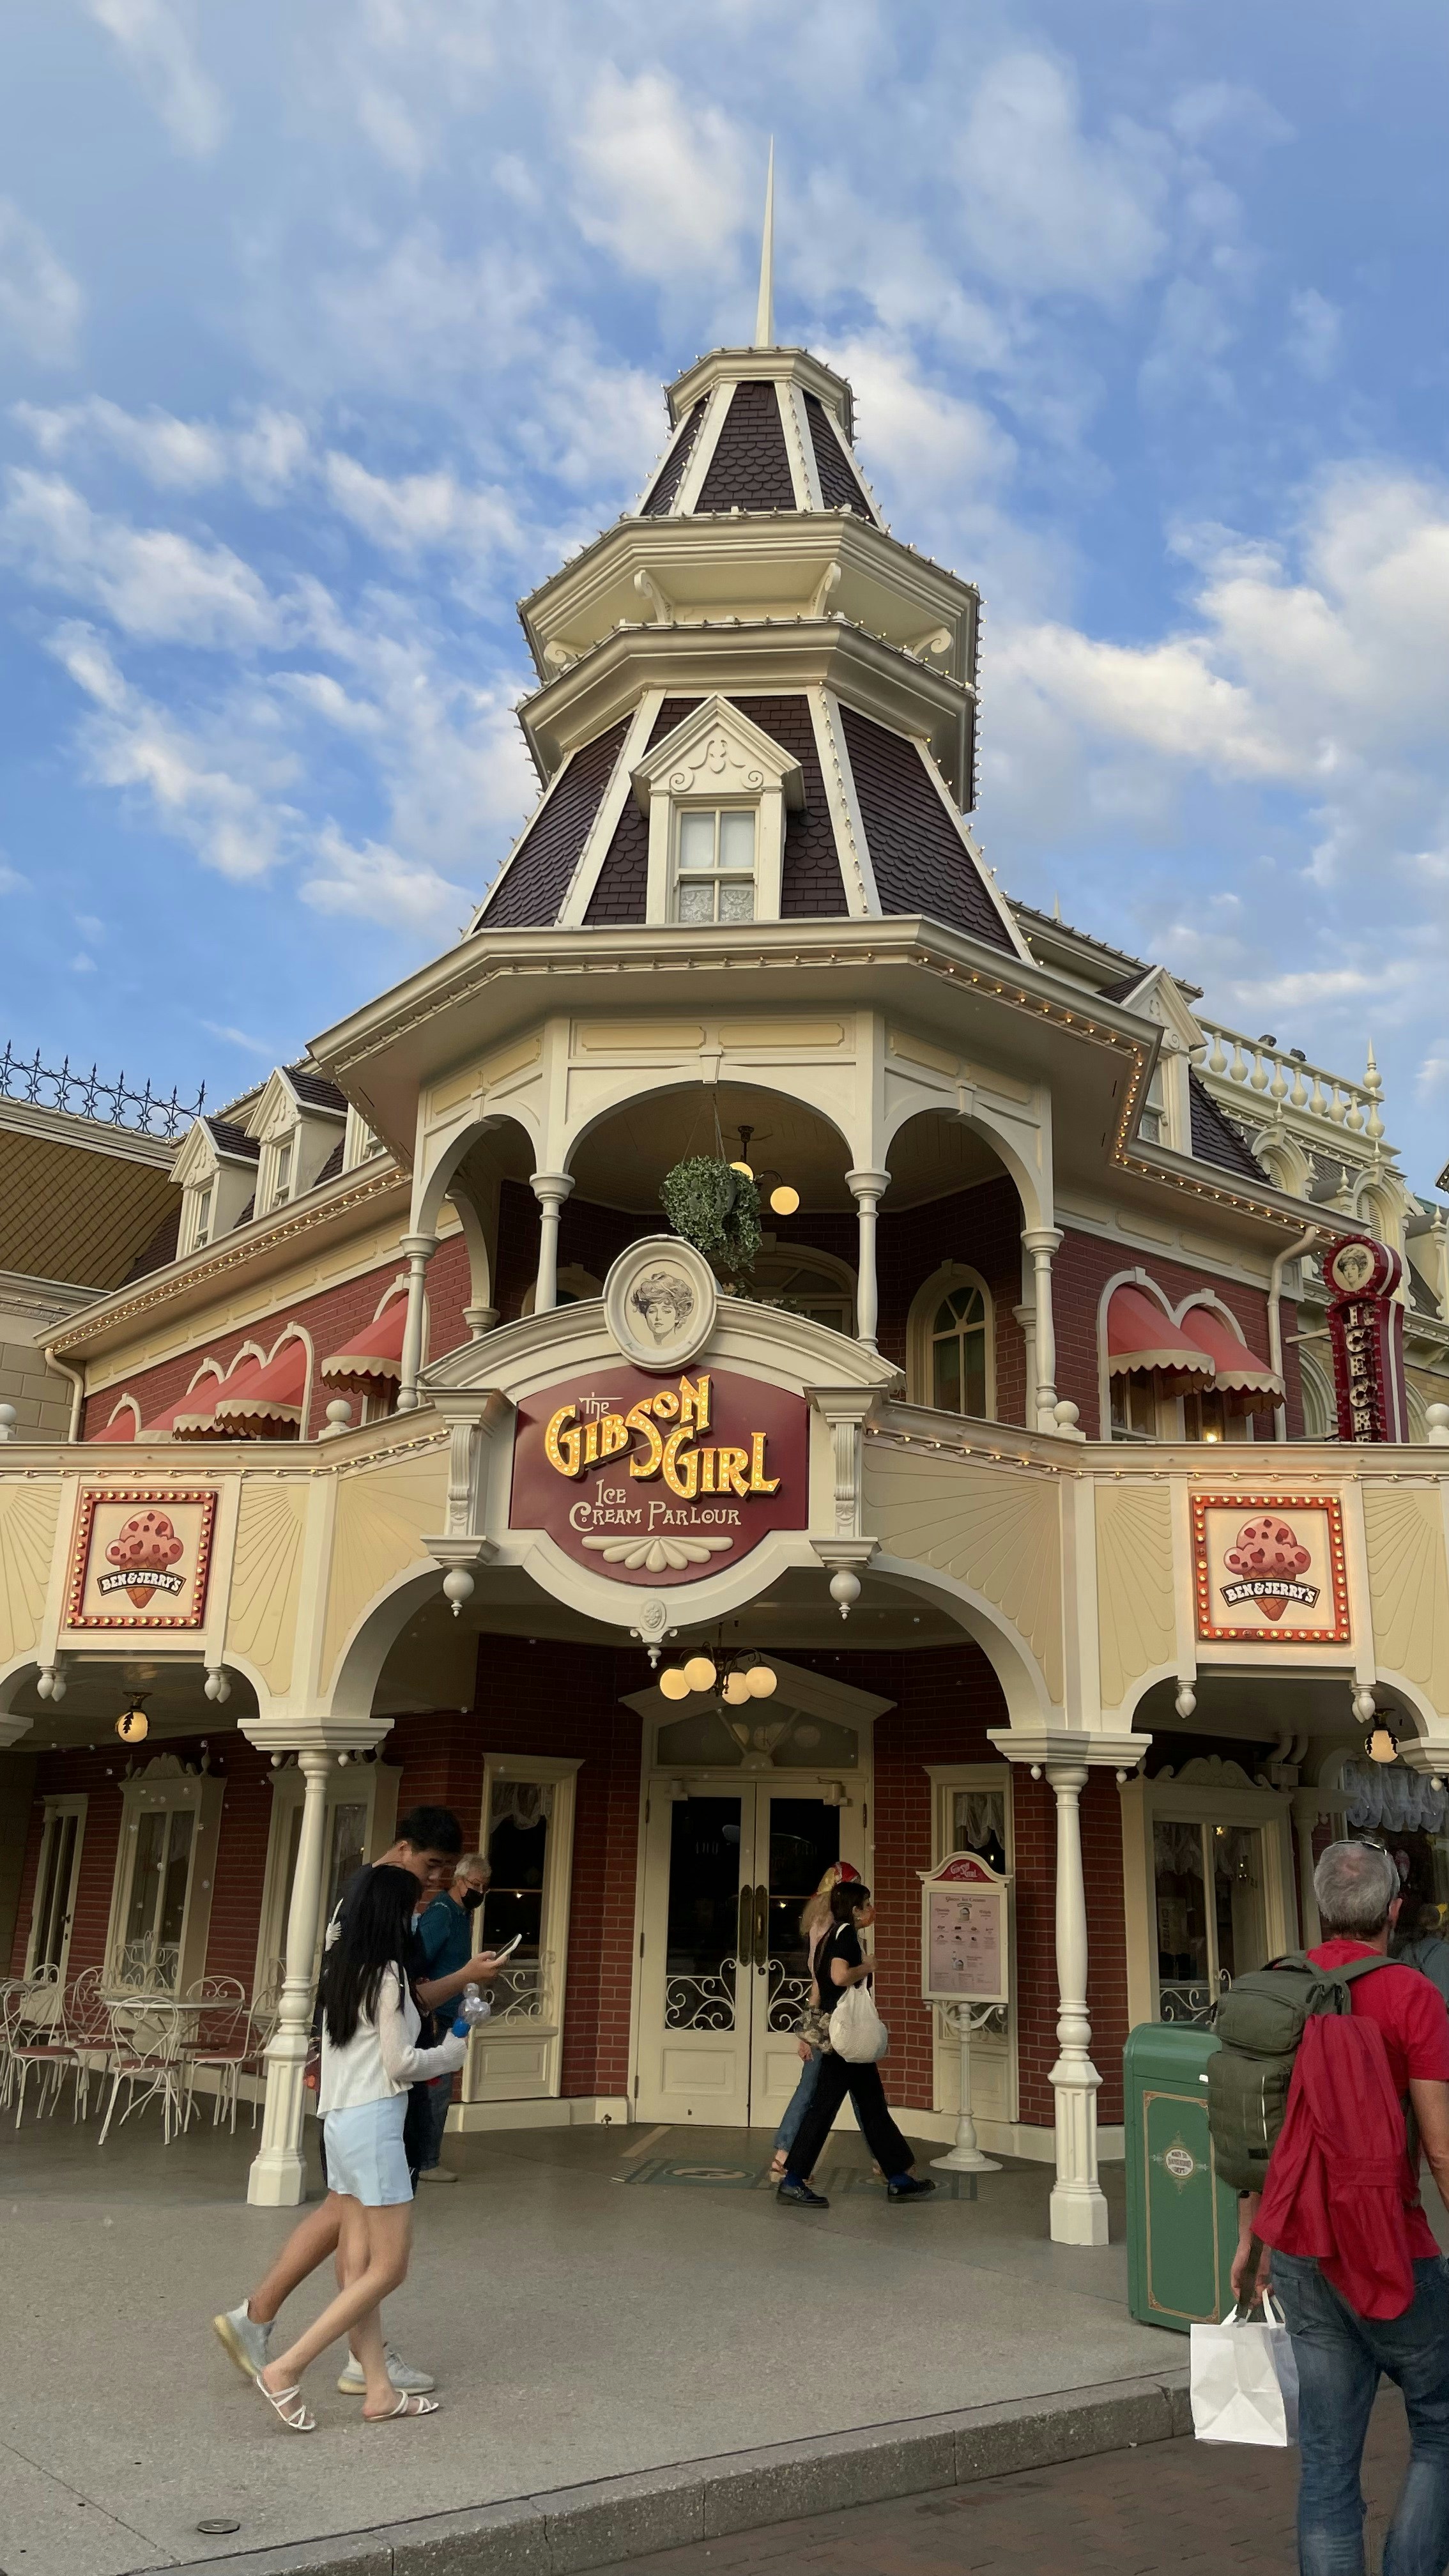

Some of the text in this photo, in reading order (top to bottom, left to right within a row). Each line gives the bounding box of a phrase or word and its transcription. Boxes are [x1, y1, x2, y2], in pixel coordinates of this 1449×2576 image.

[544, 1374, 712, 1477] GIBSON
[578, 1392, 624, 1420] The
[663, 1425, 781, 1499] GIRL
[569, 1501, 742, 1531] CREAM PARLOUR
